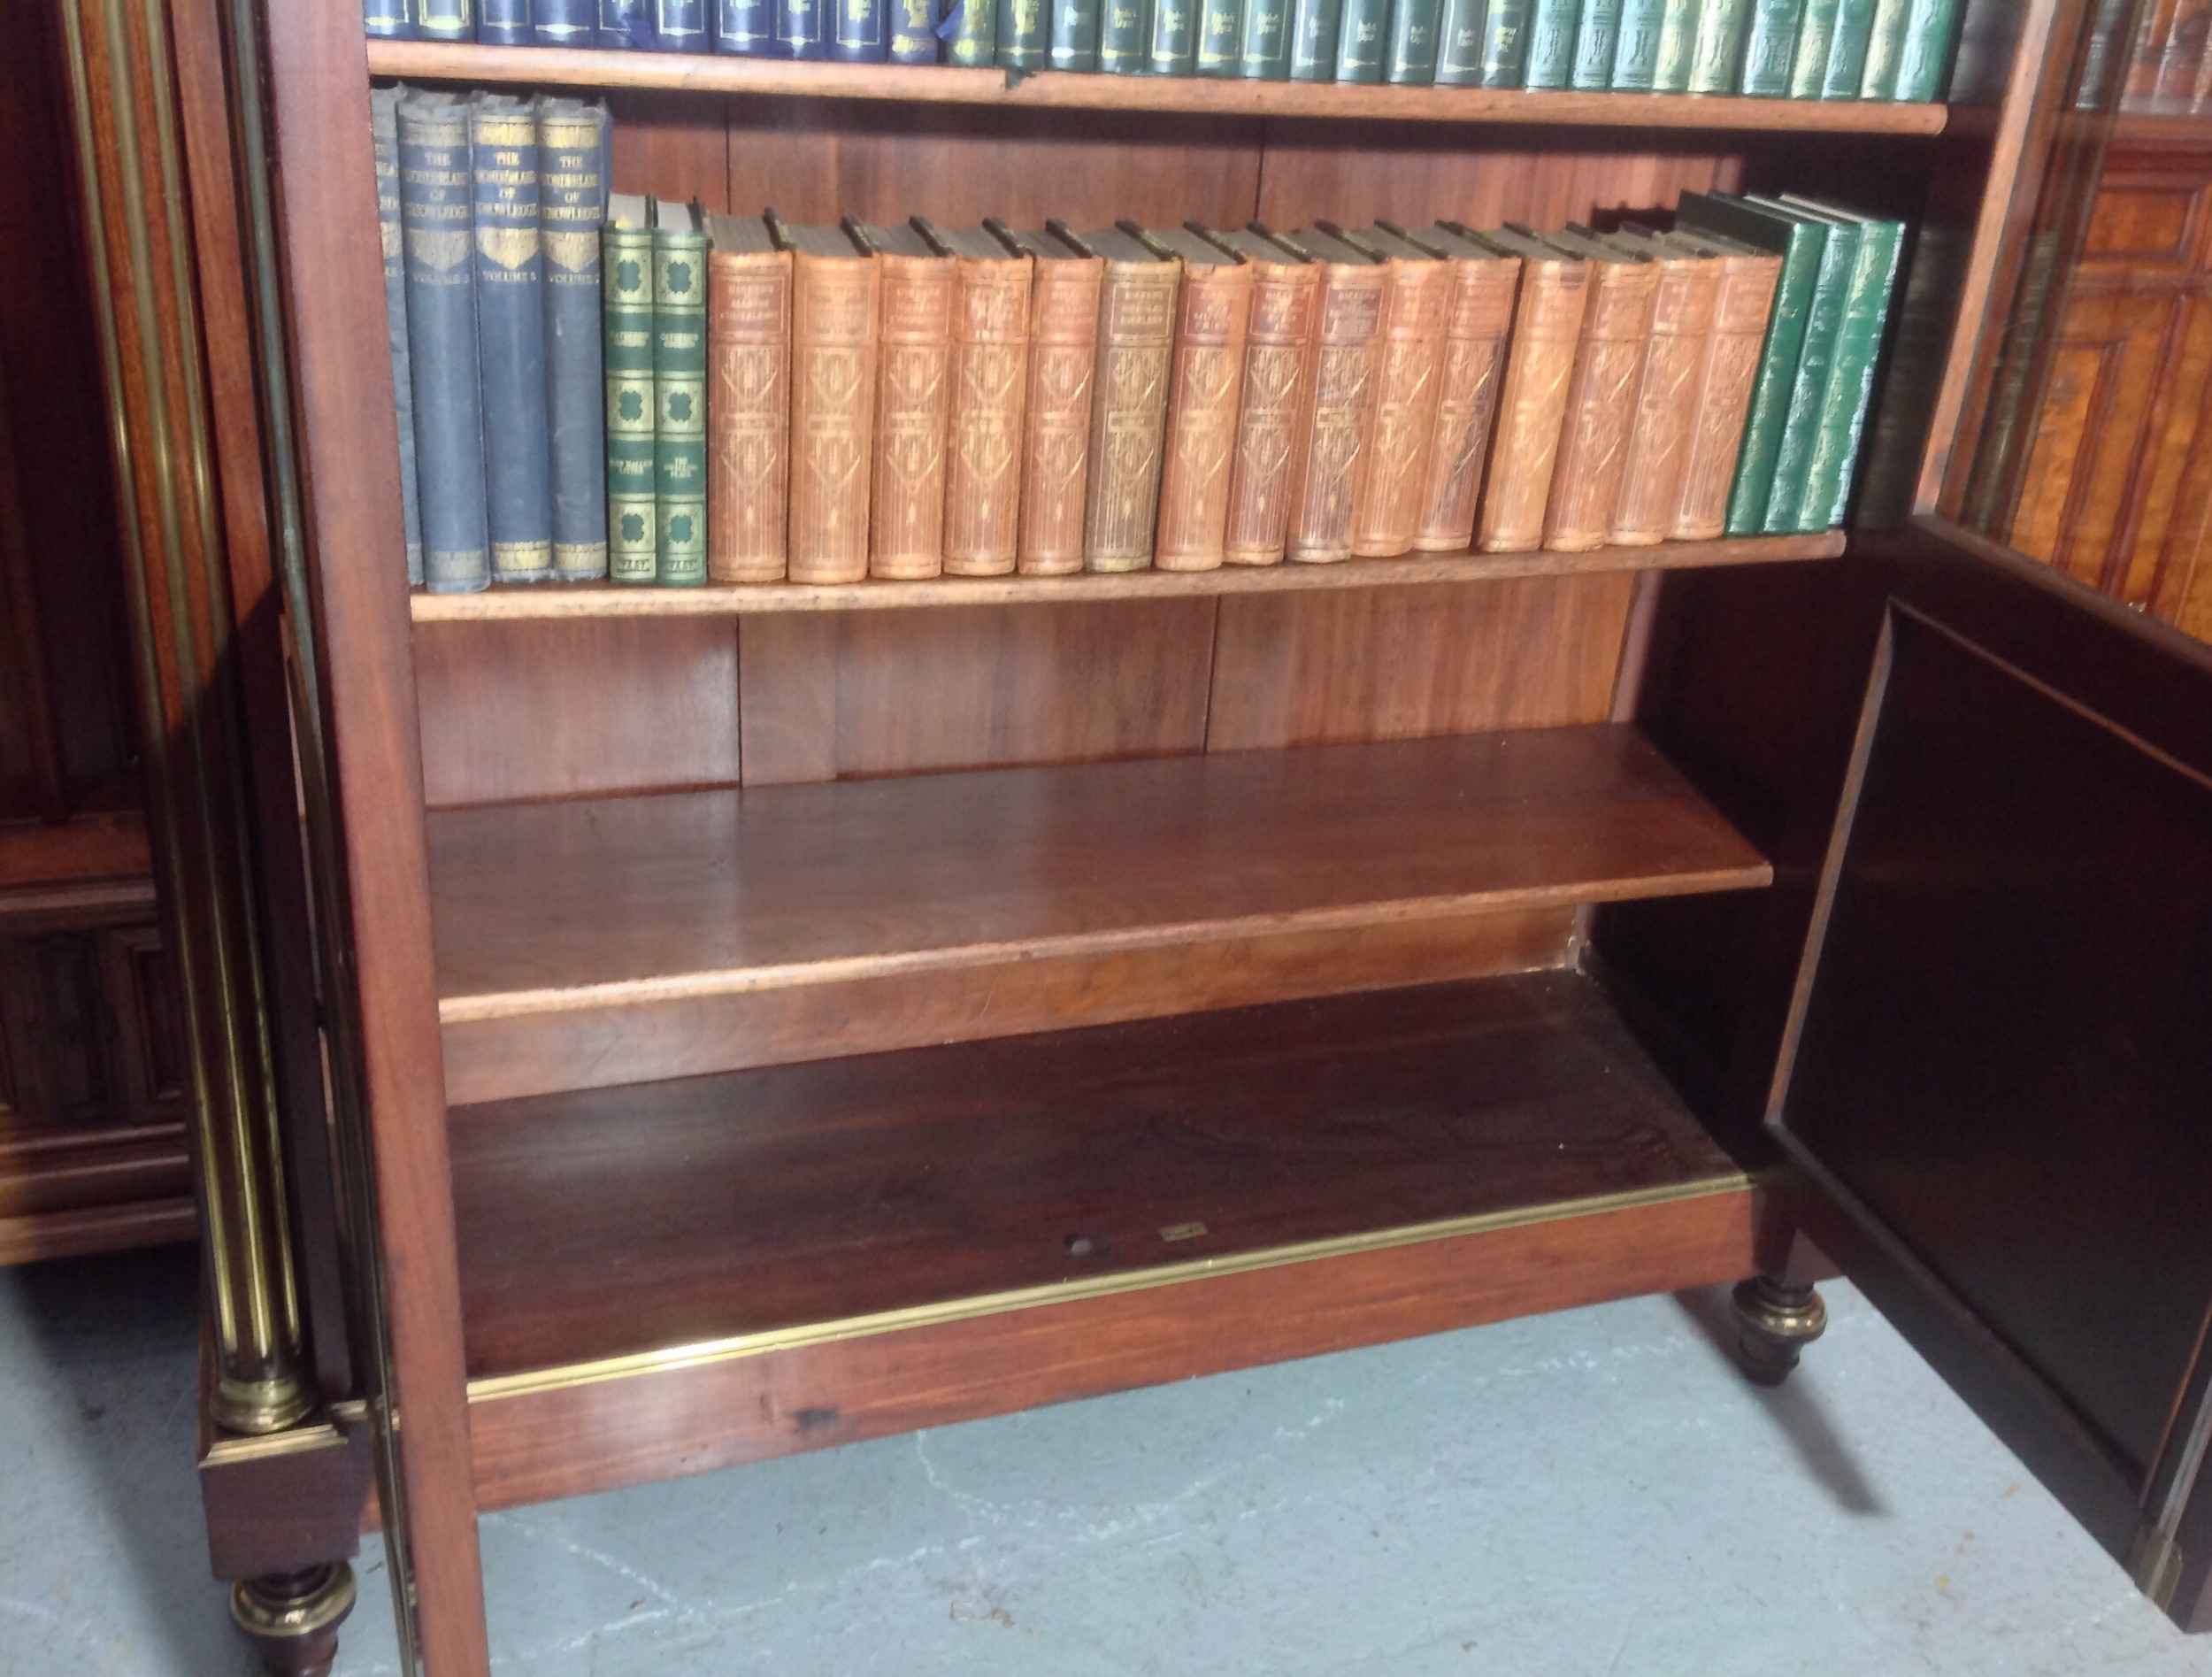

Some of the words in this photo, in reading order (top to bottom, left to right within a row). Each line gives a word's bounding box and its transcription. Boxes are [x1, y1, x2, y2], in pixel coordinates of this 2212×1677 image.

[425, 152, 450, 165] THE
[495, 151, 519, 165] THE
[559, 156, 583, 168] THE
[429, 187, 446, 201] OF
[499, 187, 516, 200] OF
[565, 191, 580, 203] OF
